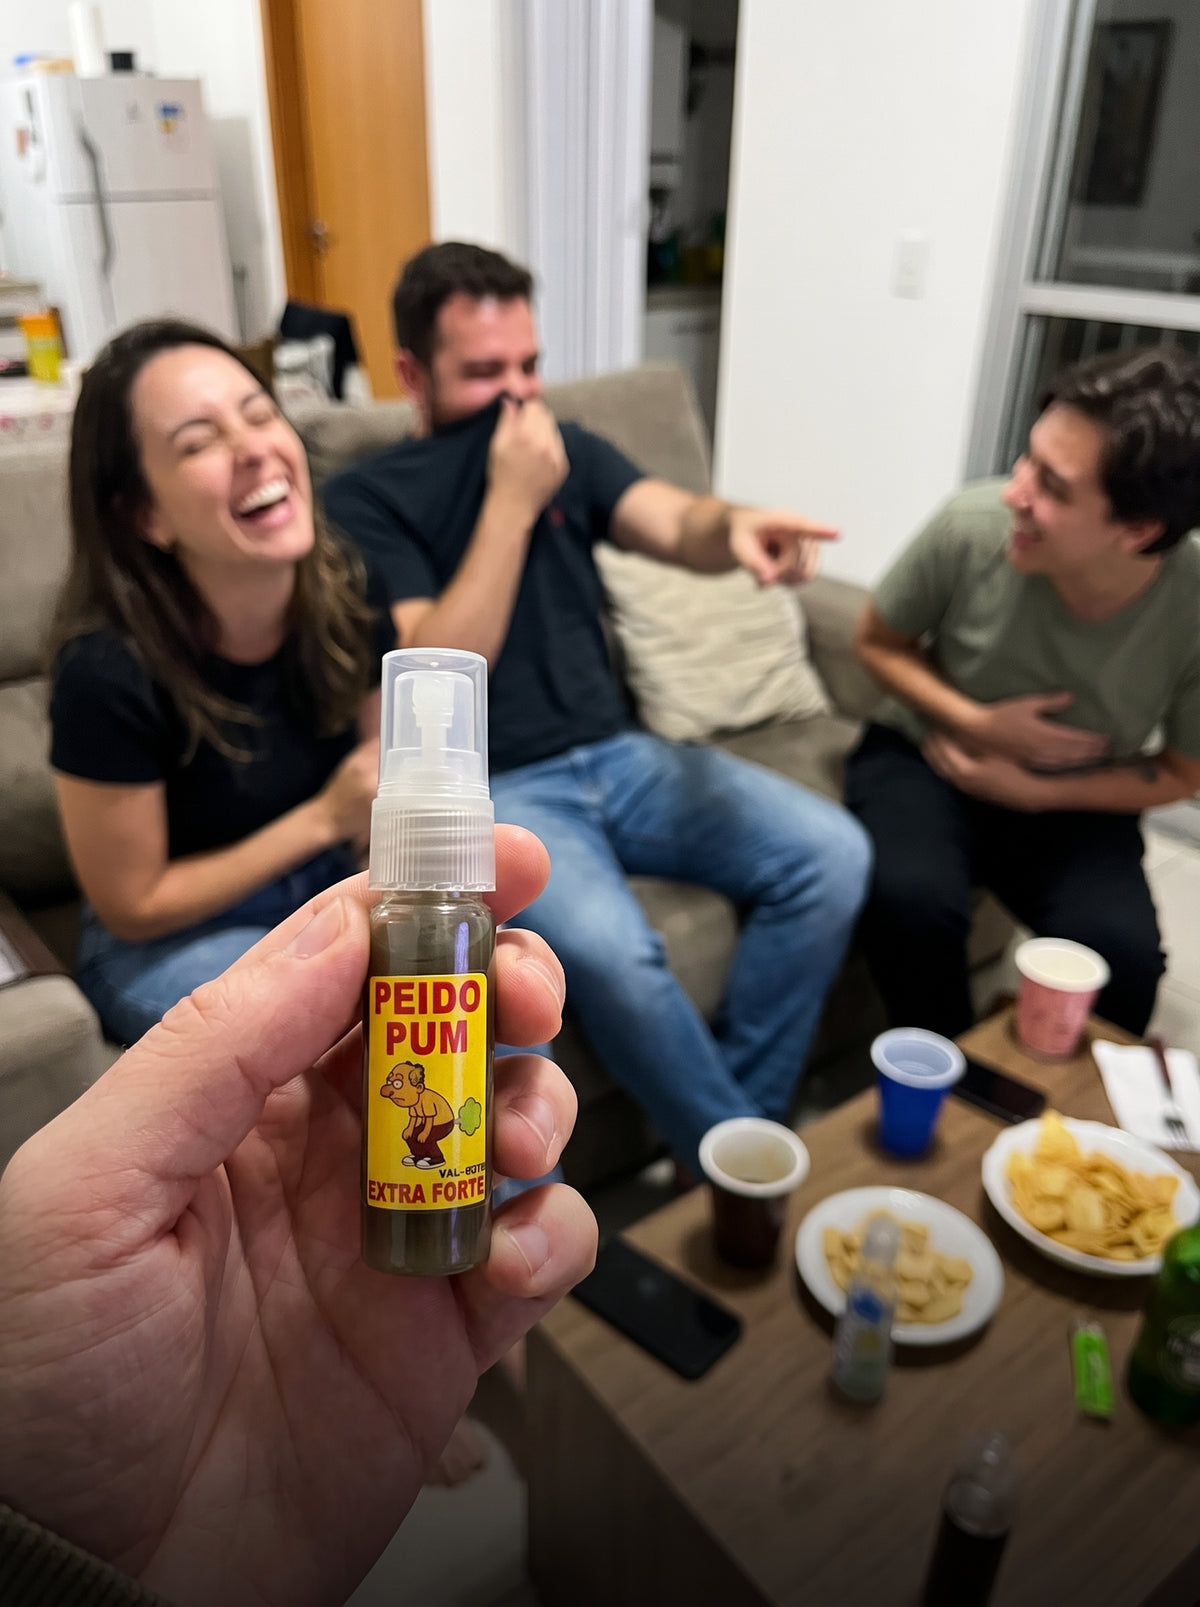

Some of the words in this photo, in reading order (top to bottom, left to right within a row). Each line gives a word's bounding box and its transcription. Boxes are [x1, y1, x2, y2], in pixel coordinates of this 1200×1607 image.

[375, 980, 480, 1015] PEIDO
[386, 1020, 467, 1056] PUM
[368, 1180, 426, 1204] EXTRA
[432, 1175, 484, 1203] FORTE
